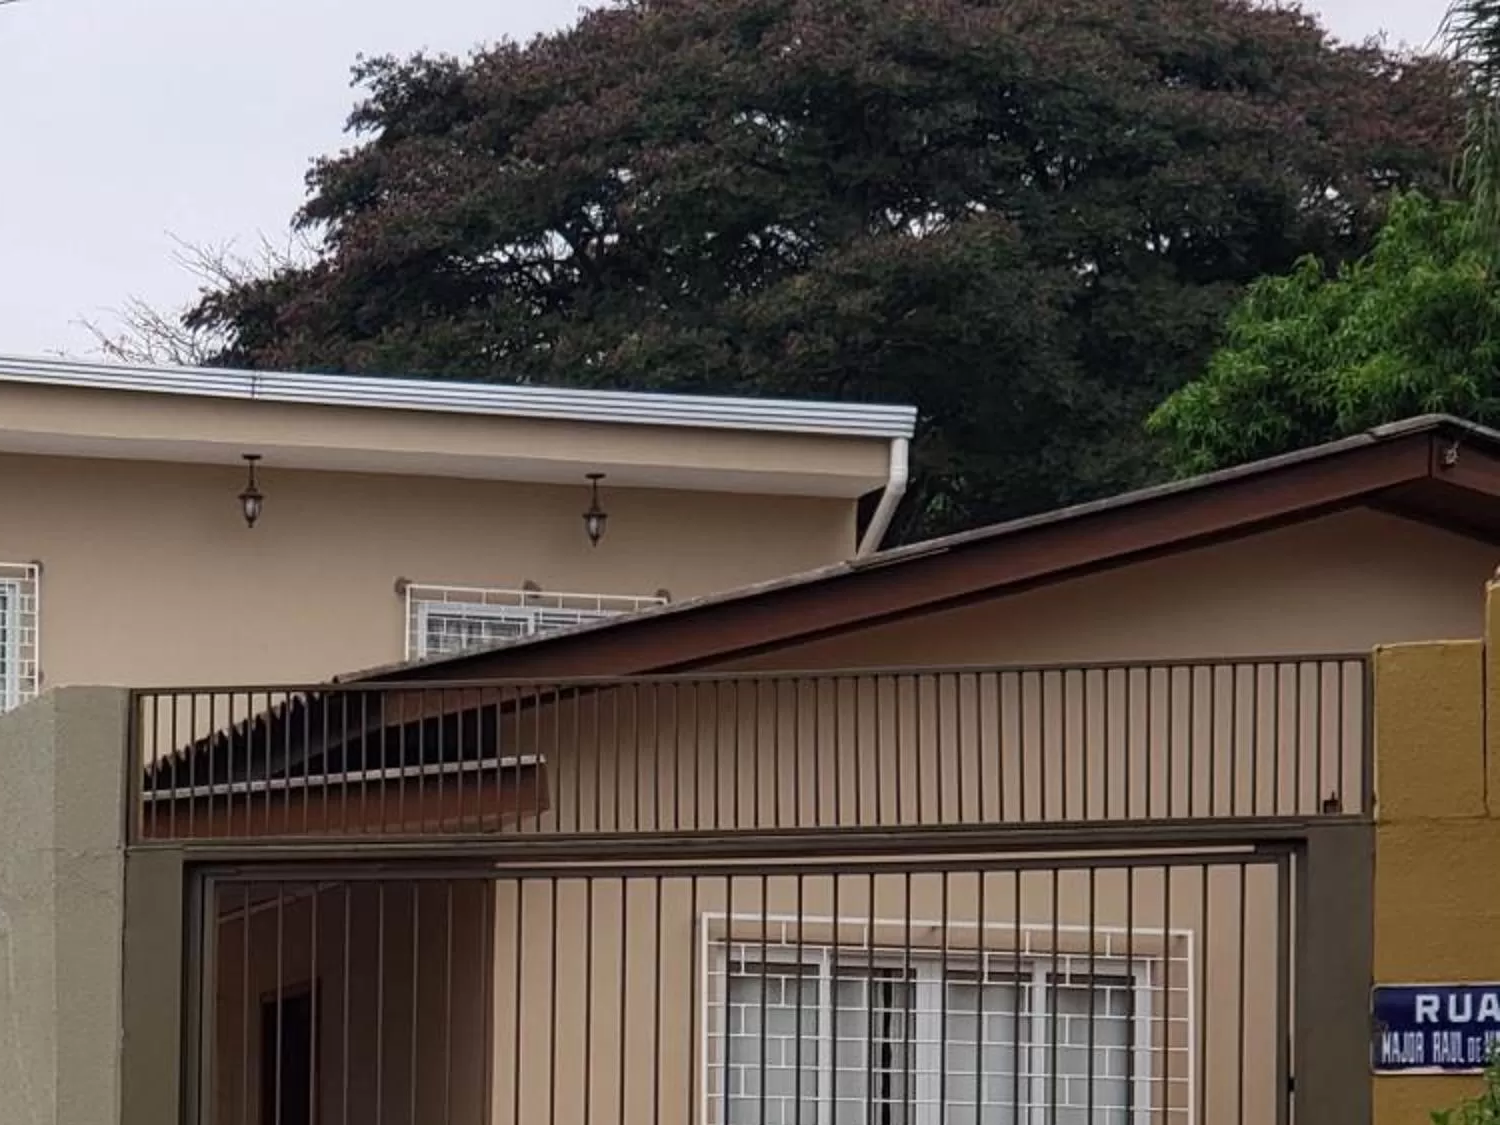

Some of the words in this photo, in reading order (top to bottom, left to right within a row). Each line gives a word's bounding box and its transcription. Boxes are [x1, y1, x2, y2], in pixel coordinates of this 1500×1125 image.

[1415, 993, 1500, 1023] RUA
[1381, 1031, 1425, 1064] MAJOR
[1432, 1030, 1466, 1063] RAUL
[1467, 1036, 1483, 1063] DE
